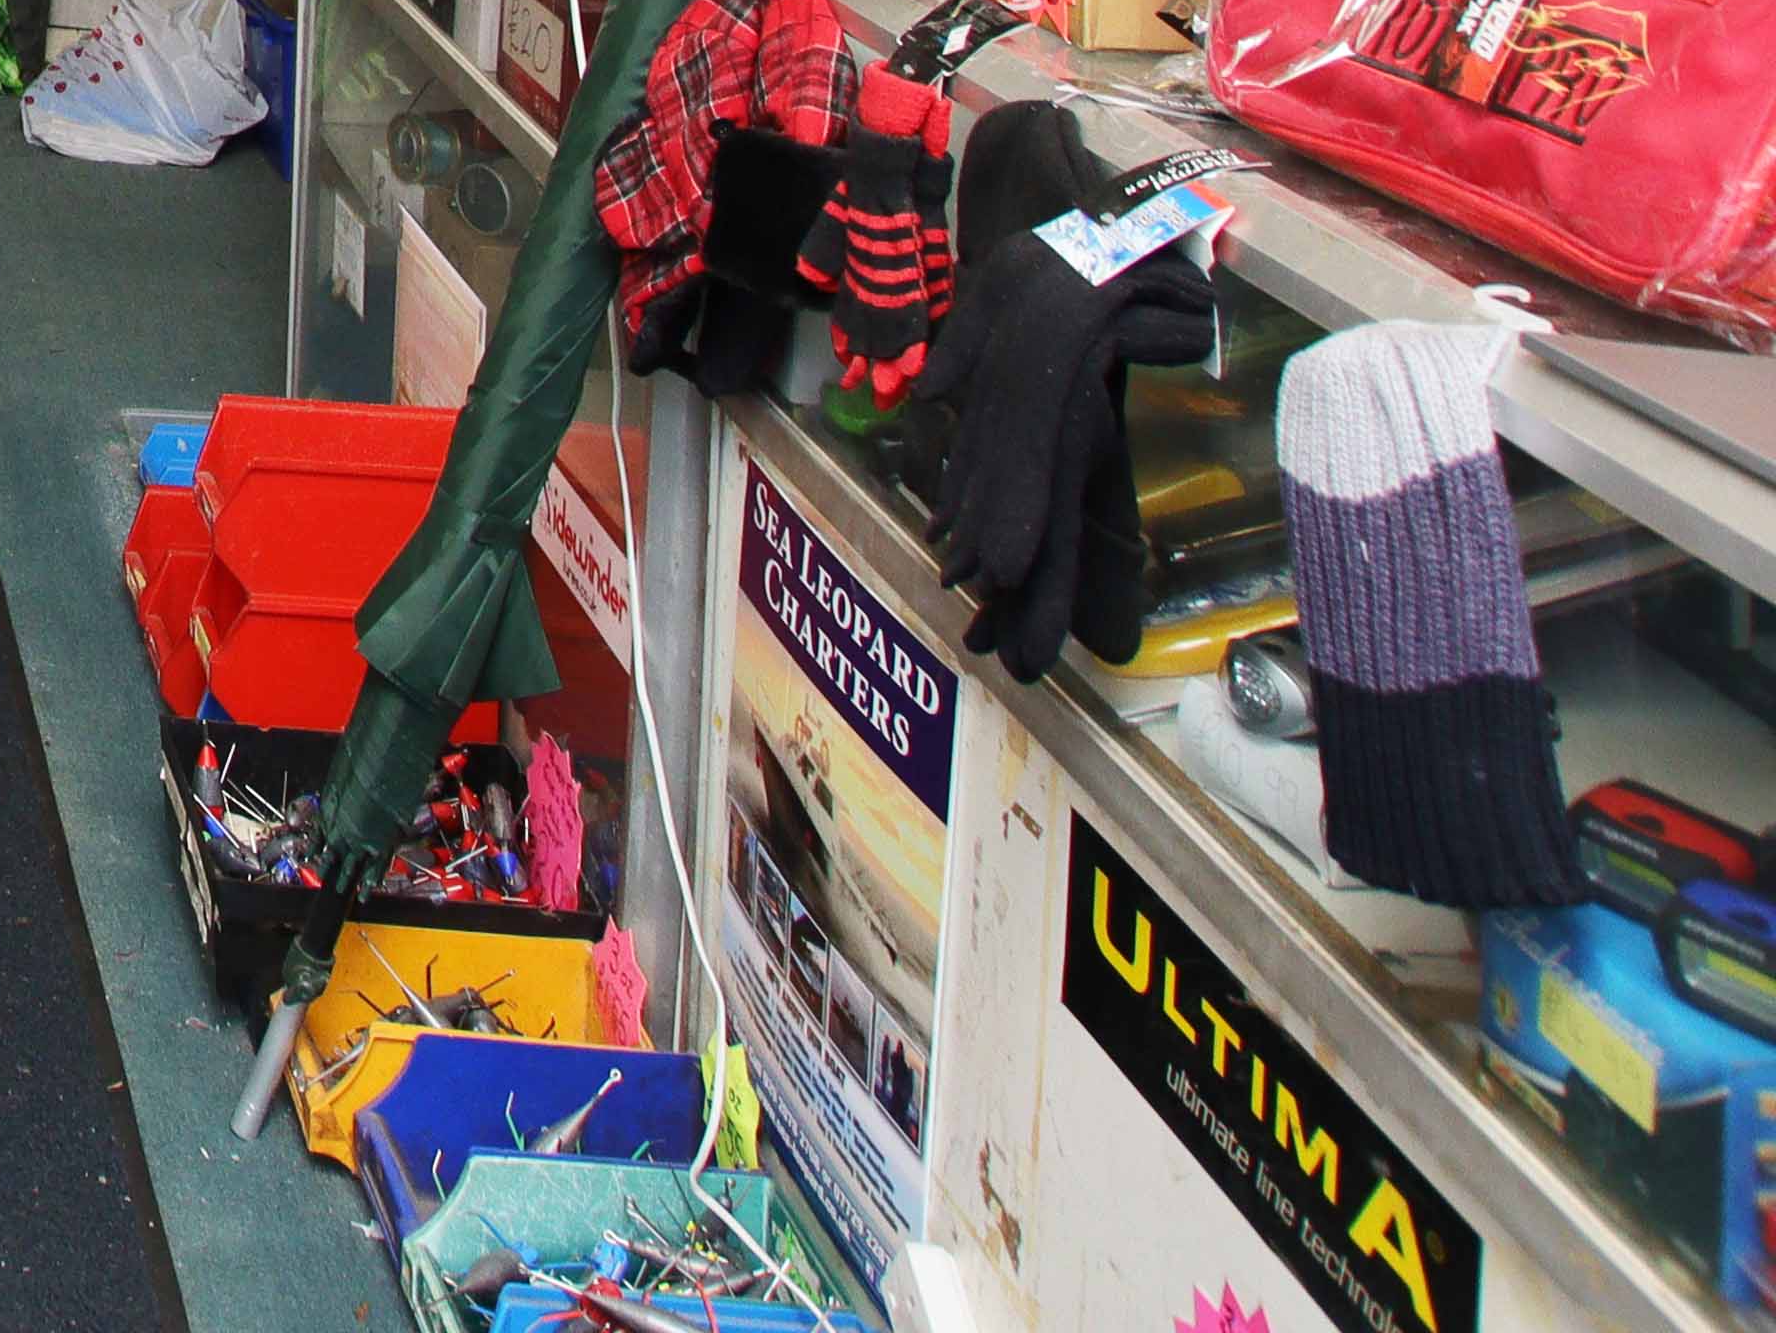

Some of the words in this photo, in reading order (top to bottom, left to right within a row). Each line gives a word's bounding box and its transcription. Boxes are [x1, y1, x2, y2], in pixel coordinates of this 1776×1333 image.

[752, 481, 795, 567] SEA
[798, 543, 940, 716] LEOPARD
[762, 559, 911, 758] CHARTERS
[1093, 865, 1440, 1333] ULTIMA
[1164, 1062, 1250, 1174] ultimate
[1255, 1160, 1296, 1229] line
